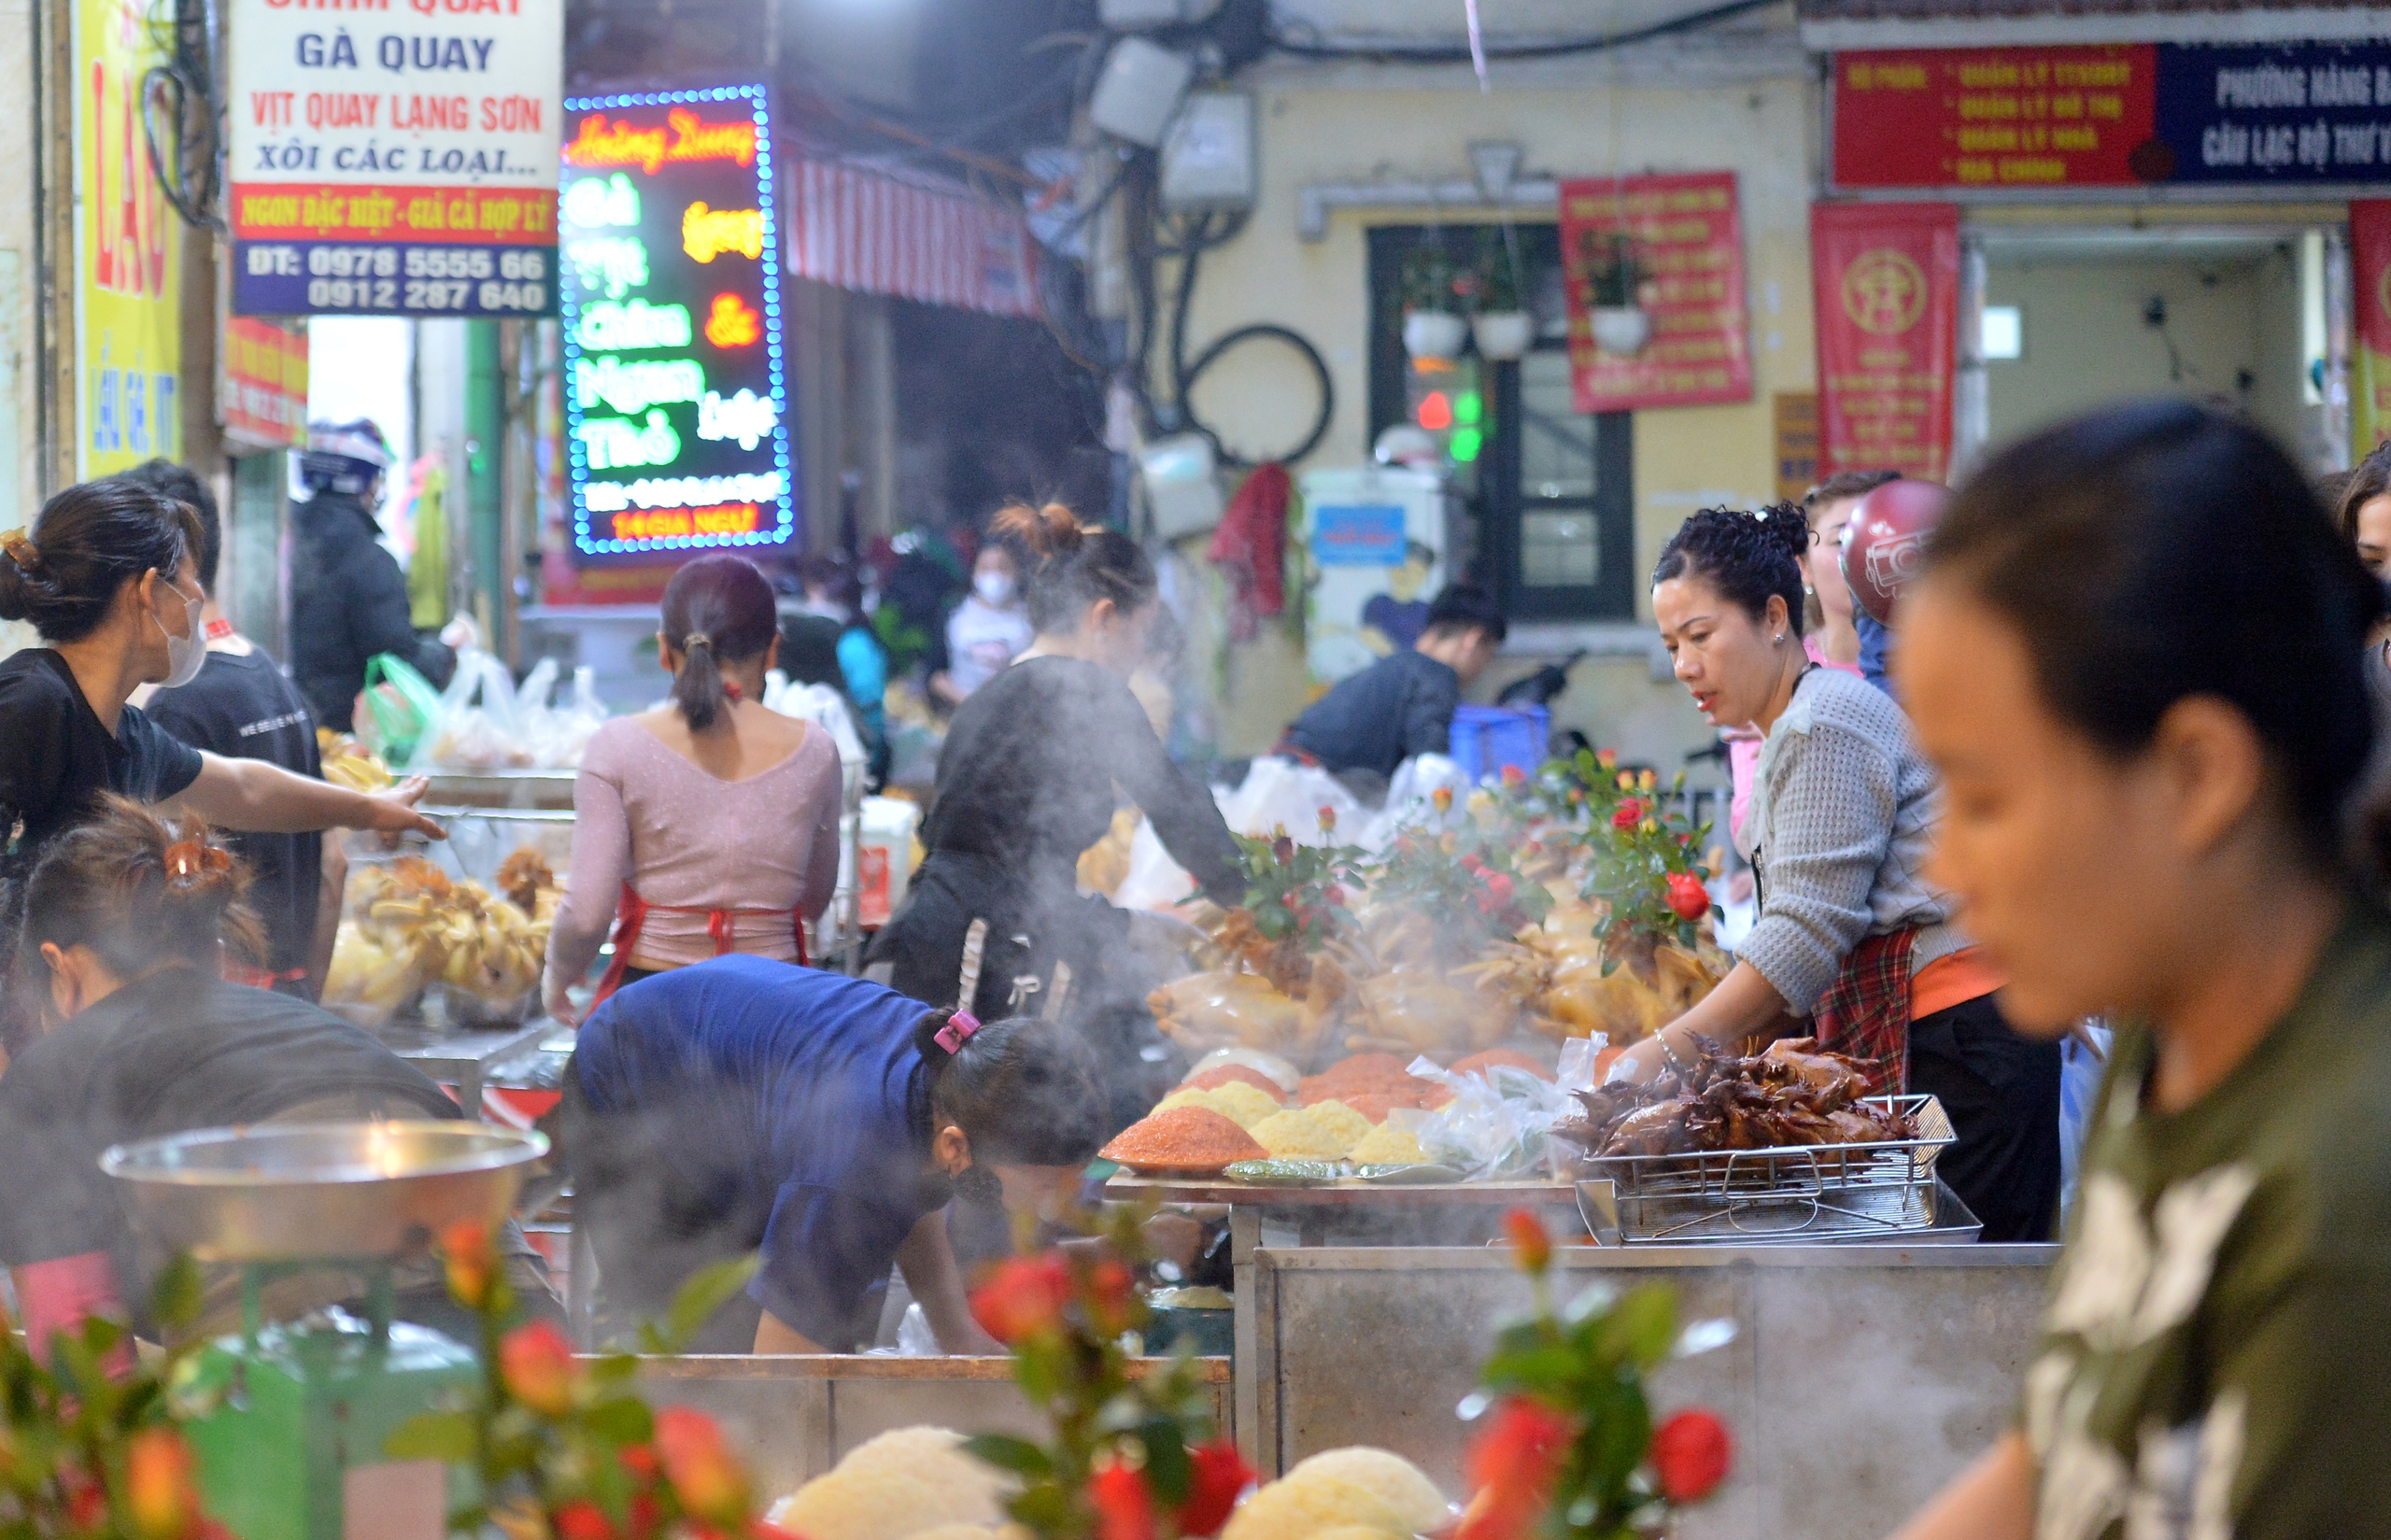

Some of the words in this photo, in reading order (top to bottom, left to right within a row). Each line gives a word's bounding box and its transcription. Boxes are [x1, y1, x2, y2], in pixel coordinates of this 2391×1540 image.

[294, 26, 359, 69] GÀ
[377, 35, 494, 75] QUAY
[249, 92, 296, 135] VỊT
[305, 92, 380, 132] QUAY
[391, 95, 469, 138] LẠNG
[480, 94, 542, 133] SƠN
[254, 137, 320, 171] XÔI
[332, 139, 406, 172] CÁC
[240, 196, 300, 227] NGON
[247, 246, 302, 277] ĐT:
[307, 247, 399, 277] 0978
[404, 249, 494, 279] 5555
[500, 251, 546, 281] 66
[307, 279, 397, 309] 0912
[403, 281, 471, 310] 287
[478, 282, 547, 312] 640
